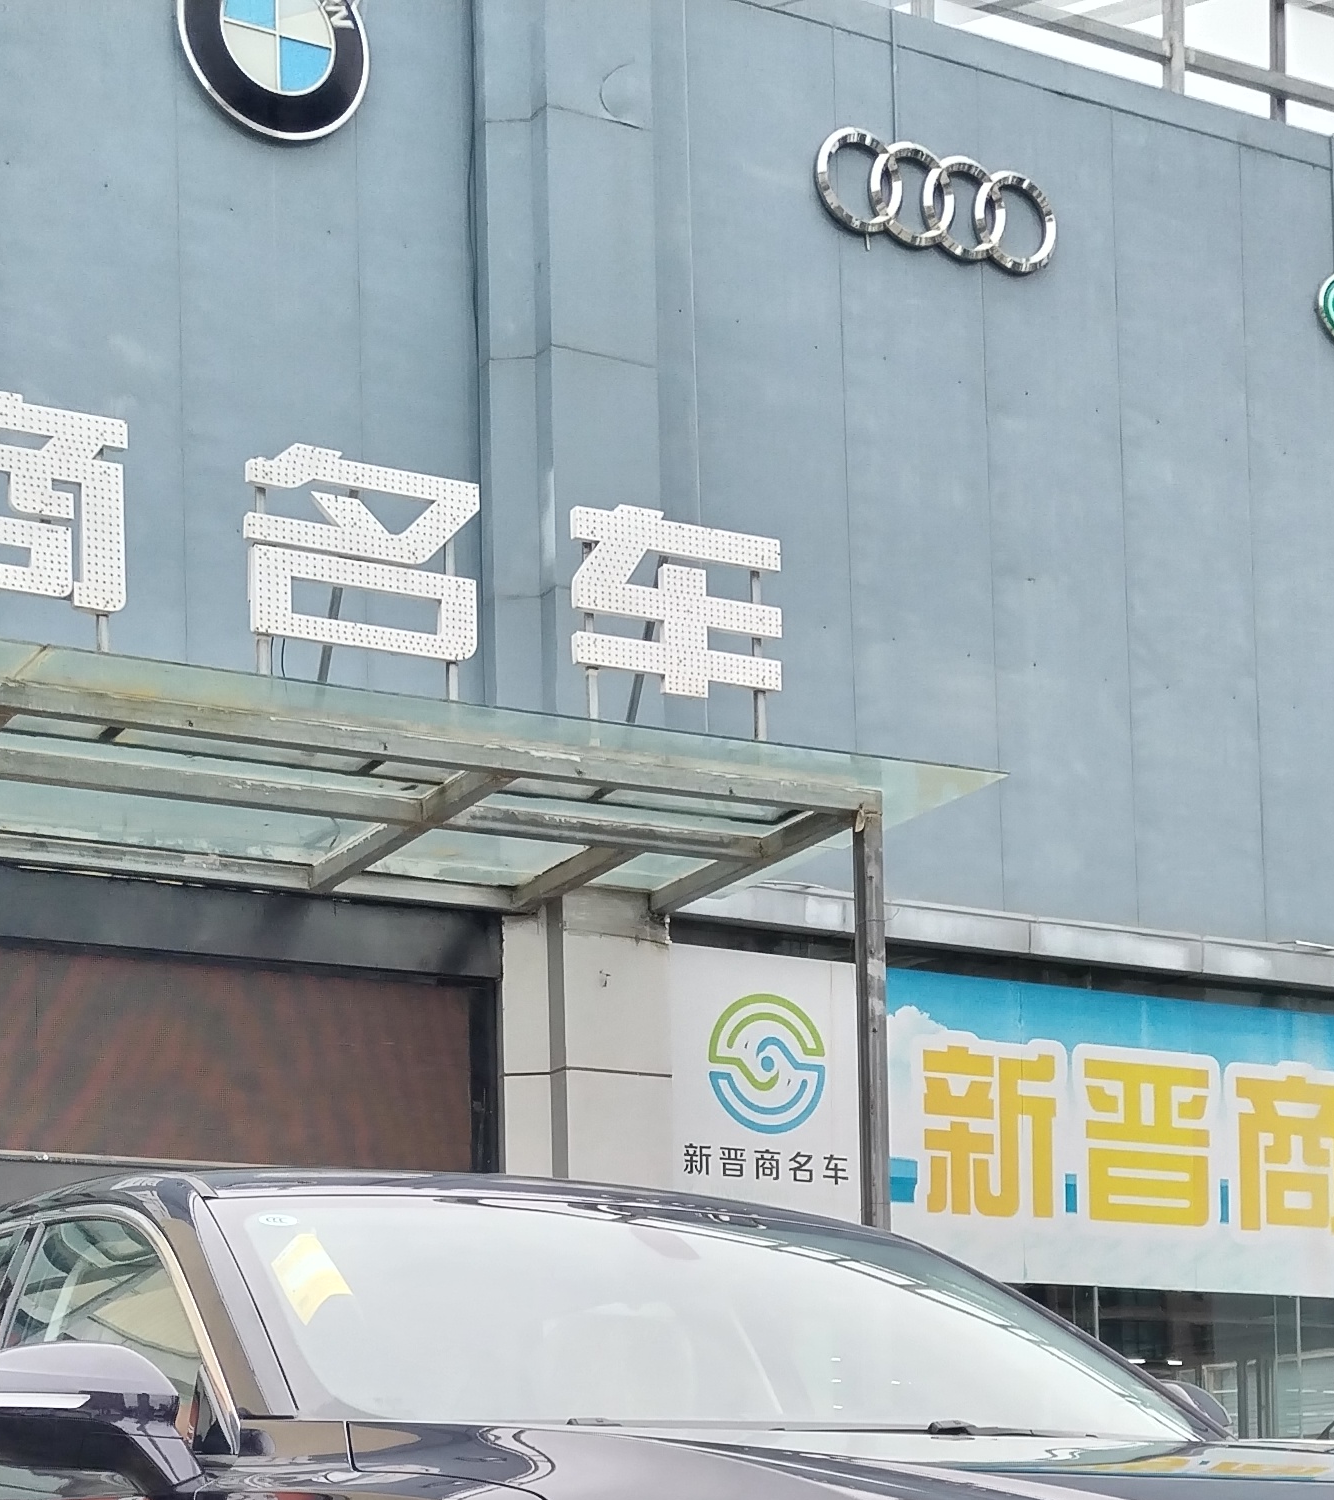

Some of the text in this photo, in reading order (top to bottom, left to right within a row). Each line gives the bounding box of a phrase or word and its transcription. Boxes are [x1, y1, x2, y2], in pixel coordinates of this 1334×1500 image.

[683, 1142, 850, 1186] 新晋商名车
